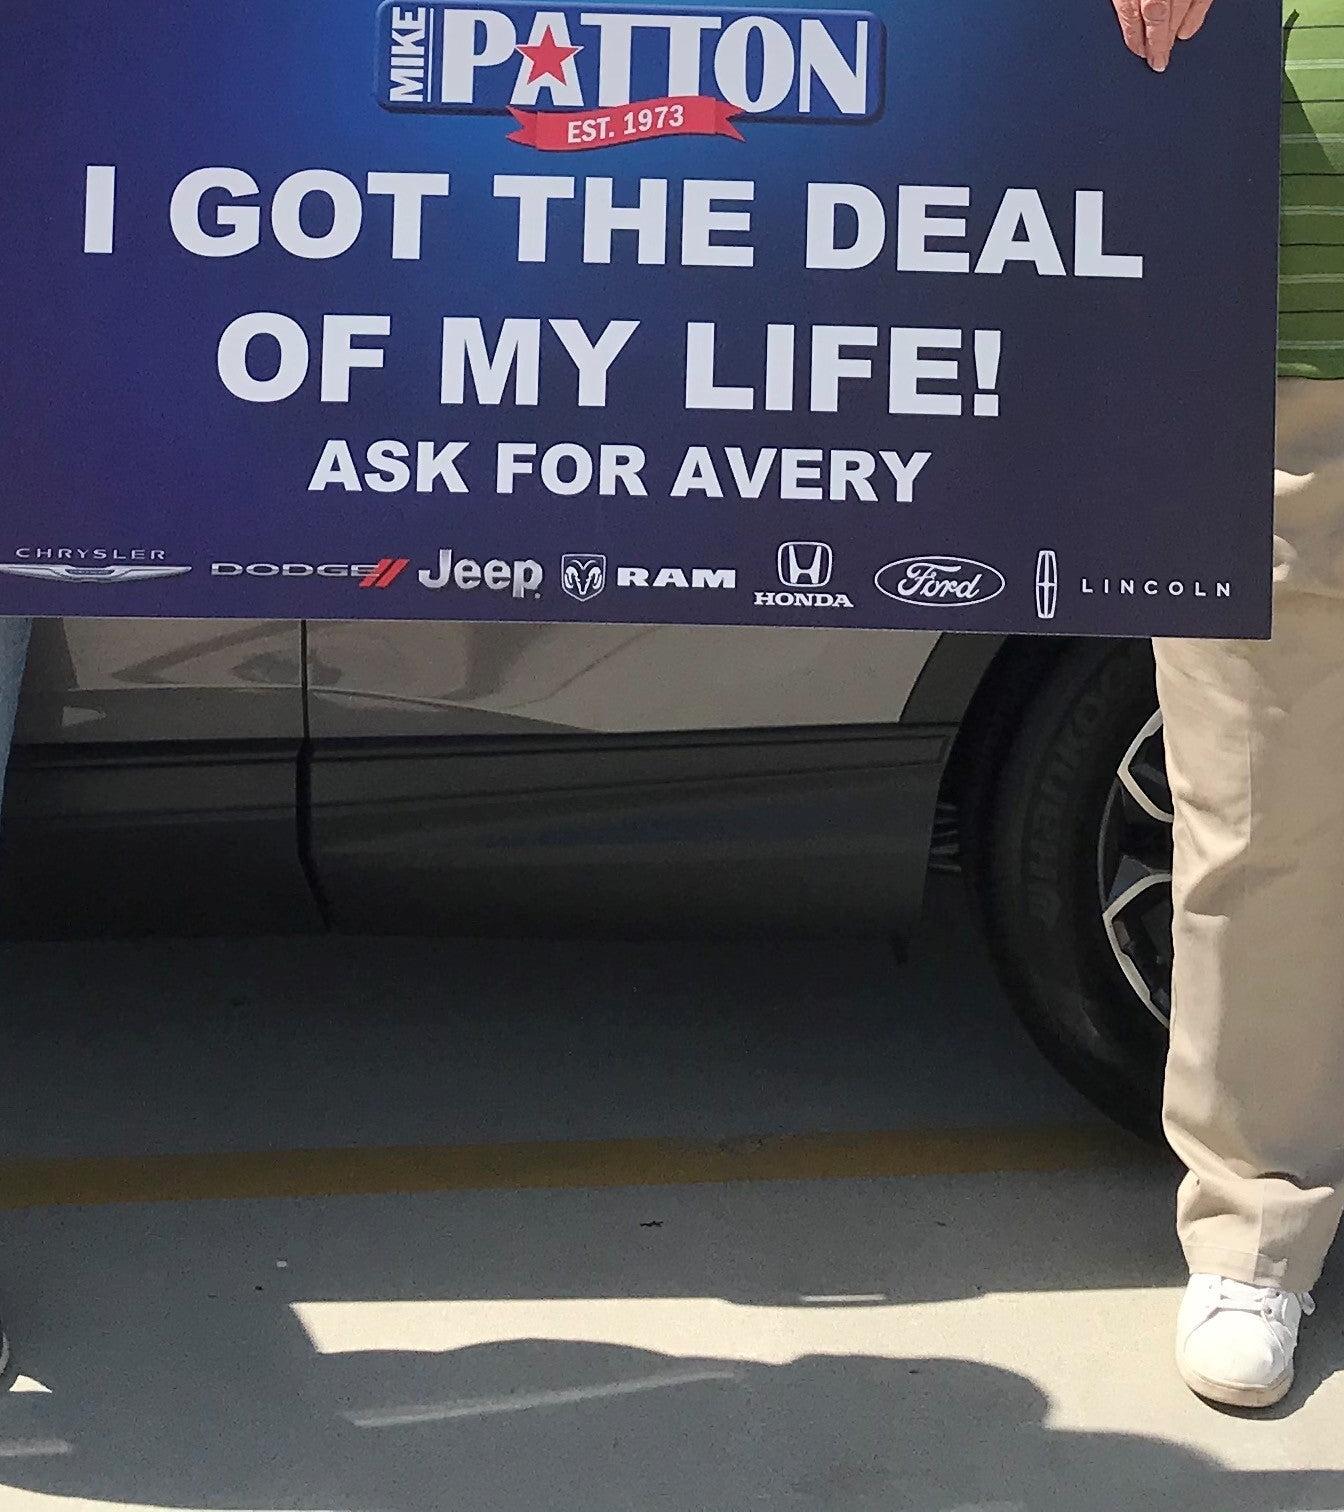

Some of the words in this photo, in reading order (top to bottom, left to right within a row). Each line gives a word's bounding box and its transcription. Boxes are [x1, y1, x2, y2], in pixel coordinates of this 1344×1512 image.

[389, 6, 426, 102] MIKE
[441, 8, 869, 116] PATTON
[567, 118, 615, 144] EST.
[622, 106, 684, 137] 1973
[83, 165, 116, 254] I
[169, 167, 450, 260] GOT
[493, 174, 755, 267] THE
[805, 182, 1144, 279] DEAL
[217, 312, 391, 403] OF
[440, 316, 641, 407] MY
[685, 321, 1002, 417] LIFE!
[307, 439, 470, 493] ASK
[496, 442, 648, 496] FOR
[669, 446, 932, 503] AVERY
[15, 547, 166, 560] CHRYSLER
[211, 562, 381, 577] DODGE
[418, 548, 543, 599] Jeep
[616, 567, 736, 589] RAM
[897, 562, 983, 598] Ford
[1082, 578, 1230, 597] LINCOLN
[753, 591, 854, 608] HONDA
